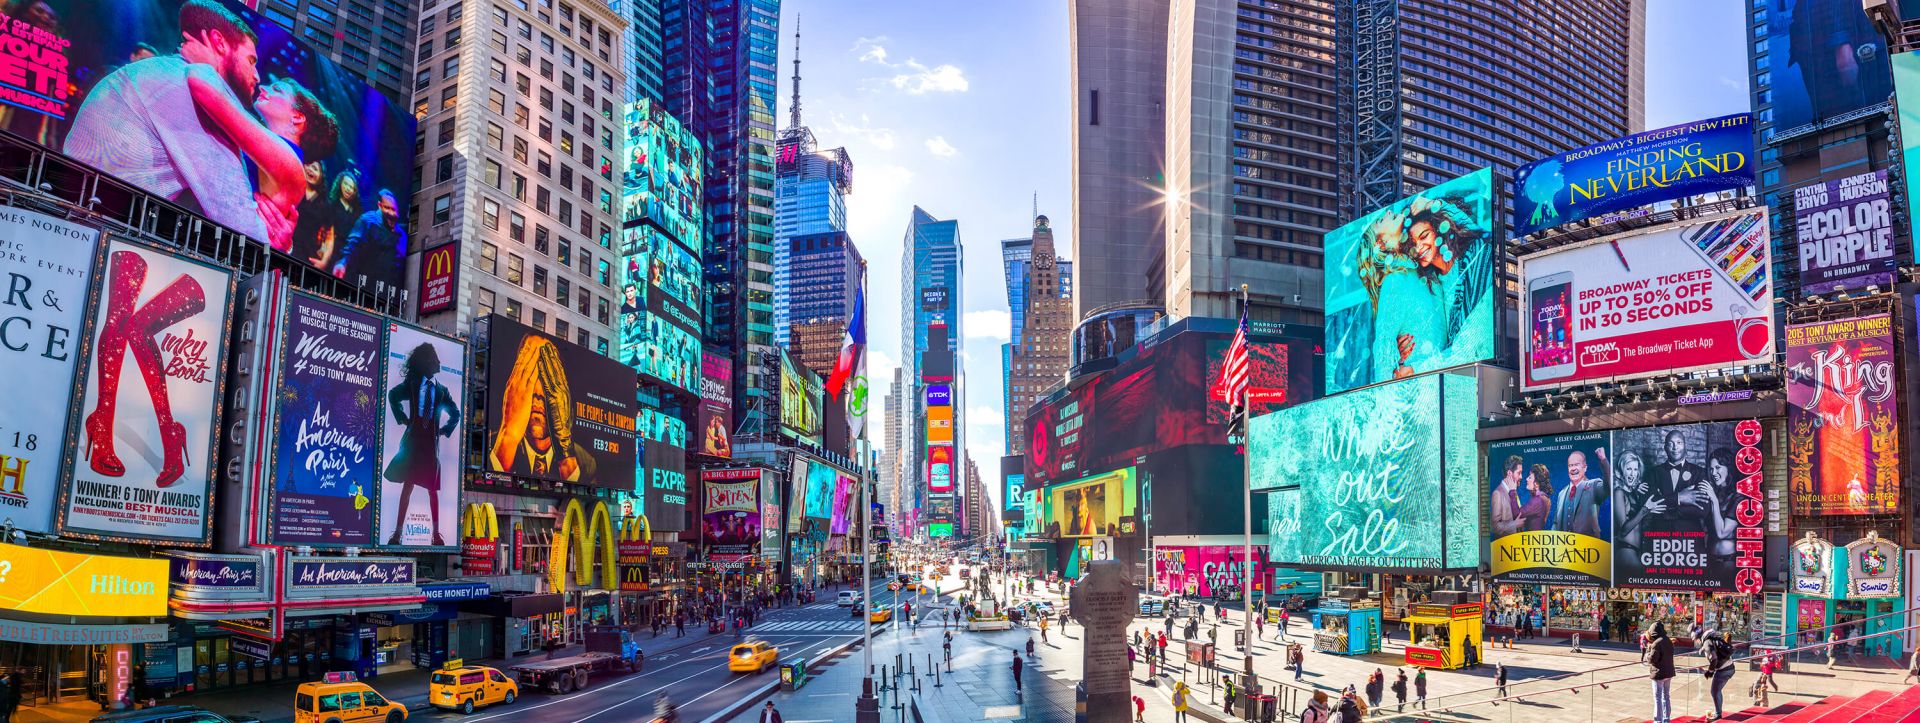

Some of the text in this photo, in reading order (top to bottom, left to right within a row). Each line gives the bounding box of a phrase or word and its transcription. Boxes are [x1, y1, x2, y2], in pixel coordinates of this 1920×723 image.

[12, 26, 62, 52] ESTEFAN
[13, 19, 71, 48] OF EMILIO
[1357, 0, 1375, 138] EAGLE AMERICAN
[1376, 15, 1394, 112] OUTFITTERS
[0, 86, 65, 116] MUSICAL
[1565, 115, 1749, 163] BROADWAY'S BIGGEST NEW HIT!
[1616, 137, 1688, 157] MATTHEW MORRISON
[1607, 142, 1702, 175] FINDING
[1569, 151, 1745, 205] NEVERLAND
[1839, 171, 1876, 190] JENNIFER
[1795, 182, 1827, 200] CYNTHIA
[1840, 179, 1888, 202] HUDSON
[1796, 193, 1829, 211] ERIVO
[1798, 213, 1813, 244] THE
[1811, 199, 1890, 241] COLOR
[31, 219, 91, 243] NORTON
[1800, 228, 1894, 272] PURPLE
[38, 259, 85, 278] EVENT
[1823, 263, 1871, 278] ON BROADWAY
[427, 276, 449, 288] OPEN
[1579, 268, 1713, 300] BROADWAY TICKETS
[42, 289, 63, 312] &
[423, 296, 450, 308] HOURS
[429, 287, 446, 299] 24
[1579, 281, 1713, 315] UP TO 50% OFF
[298, 305, 311, 317] THE
[312, 307, 328, 320] MOST
[329, 312, 376, 334] AWARD-WINNING
[1580, 297, 1713, 330] IN 30 SECONDS
[300, 316, 374, 343] MUSICAL OF THE SEASON!
[1253, 321, 1286, 329] MARRIOTT
[1788, 316, 1891, 340] 2015 TONY AWARD WINNER!
[1584, 341, 1617, 354] TODAY
[1623, 337, 1714, 357] The Broadway Ticket App
[1788, 329, 1890, 346] BEST REVIVAL OF A MUSICAL
[294, 331, 376, 372] Winner!
[1591, 351, 1609, 363] TIX
[163, 355, 212, 384] Boots
[309, 364, 373, 387] 2015 TONY AWARDS
[1790, 362, 1813, 383] The
[1805, 345, 1895, 410] King
[701, 377, 726, 395] SPRING
[1680, 390, 1751, 405] OUTFRONT PRIME
[311, 401, 330, 428] An
[576, 401, 635, 431] THE PEOPLE SIMPSON
[1813, 407, 1845, 429] and
[1844, 385, 1871, 433] I
[295, 418, 365, 463] American
[593, 438, 605, 450] FEB
[1491, 441, 1516, 449] MATTHEW
[1516, 438, 1543, 447] MORRISON
[1574, 433, 1602, 441] GRAMMER
[305, 449, 350, 478] Paris
[77, 480, 201, 508] WINNER! 6 TONY AWARDS
[1335, 461, 1405, 507] out
[75, 496, 199, 517] INCLUDING BEST MUSICAL
[1735, 419, 1764, 595] CHICAGO
[1796, 494, 1826, 502] LINCOLN
[1320, 508, 1409, 557] Sale
[1521, 534, 1576, 546] FINDING
[652, 546, 668, 555] PRESS
[1500, 545, 1600, 566] NEVERLAND
[1653, 539, 1695, 553] EDDIE
[1301, 555, 1442, 568] AMERICAN EAGLE OUTFITTERS
[1641, 552, 1708, 567] GEORGE
[300, 563, 389, 584] An American Paris
[1628, 577, 1721, 587] CHICAGOTHEMUSICAL.COM
[91, 574, 155, 595] Hilton
[444, 584, 490, 598] MONEY ATM
[1798, 580, 1820, 591] Sanrio
[1860, 582, 1888, 592] Sanrio
[1563, 589, 1673, 604] GRAND SLAM
[132, 627, 144, 635] BY
